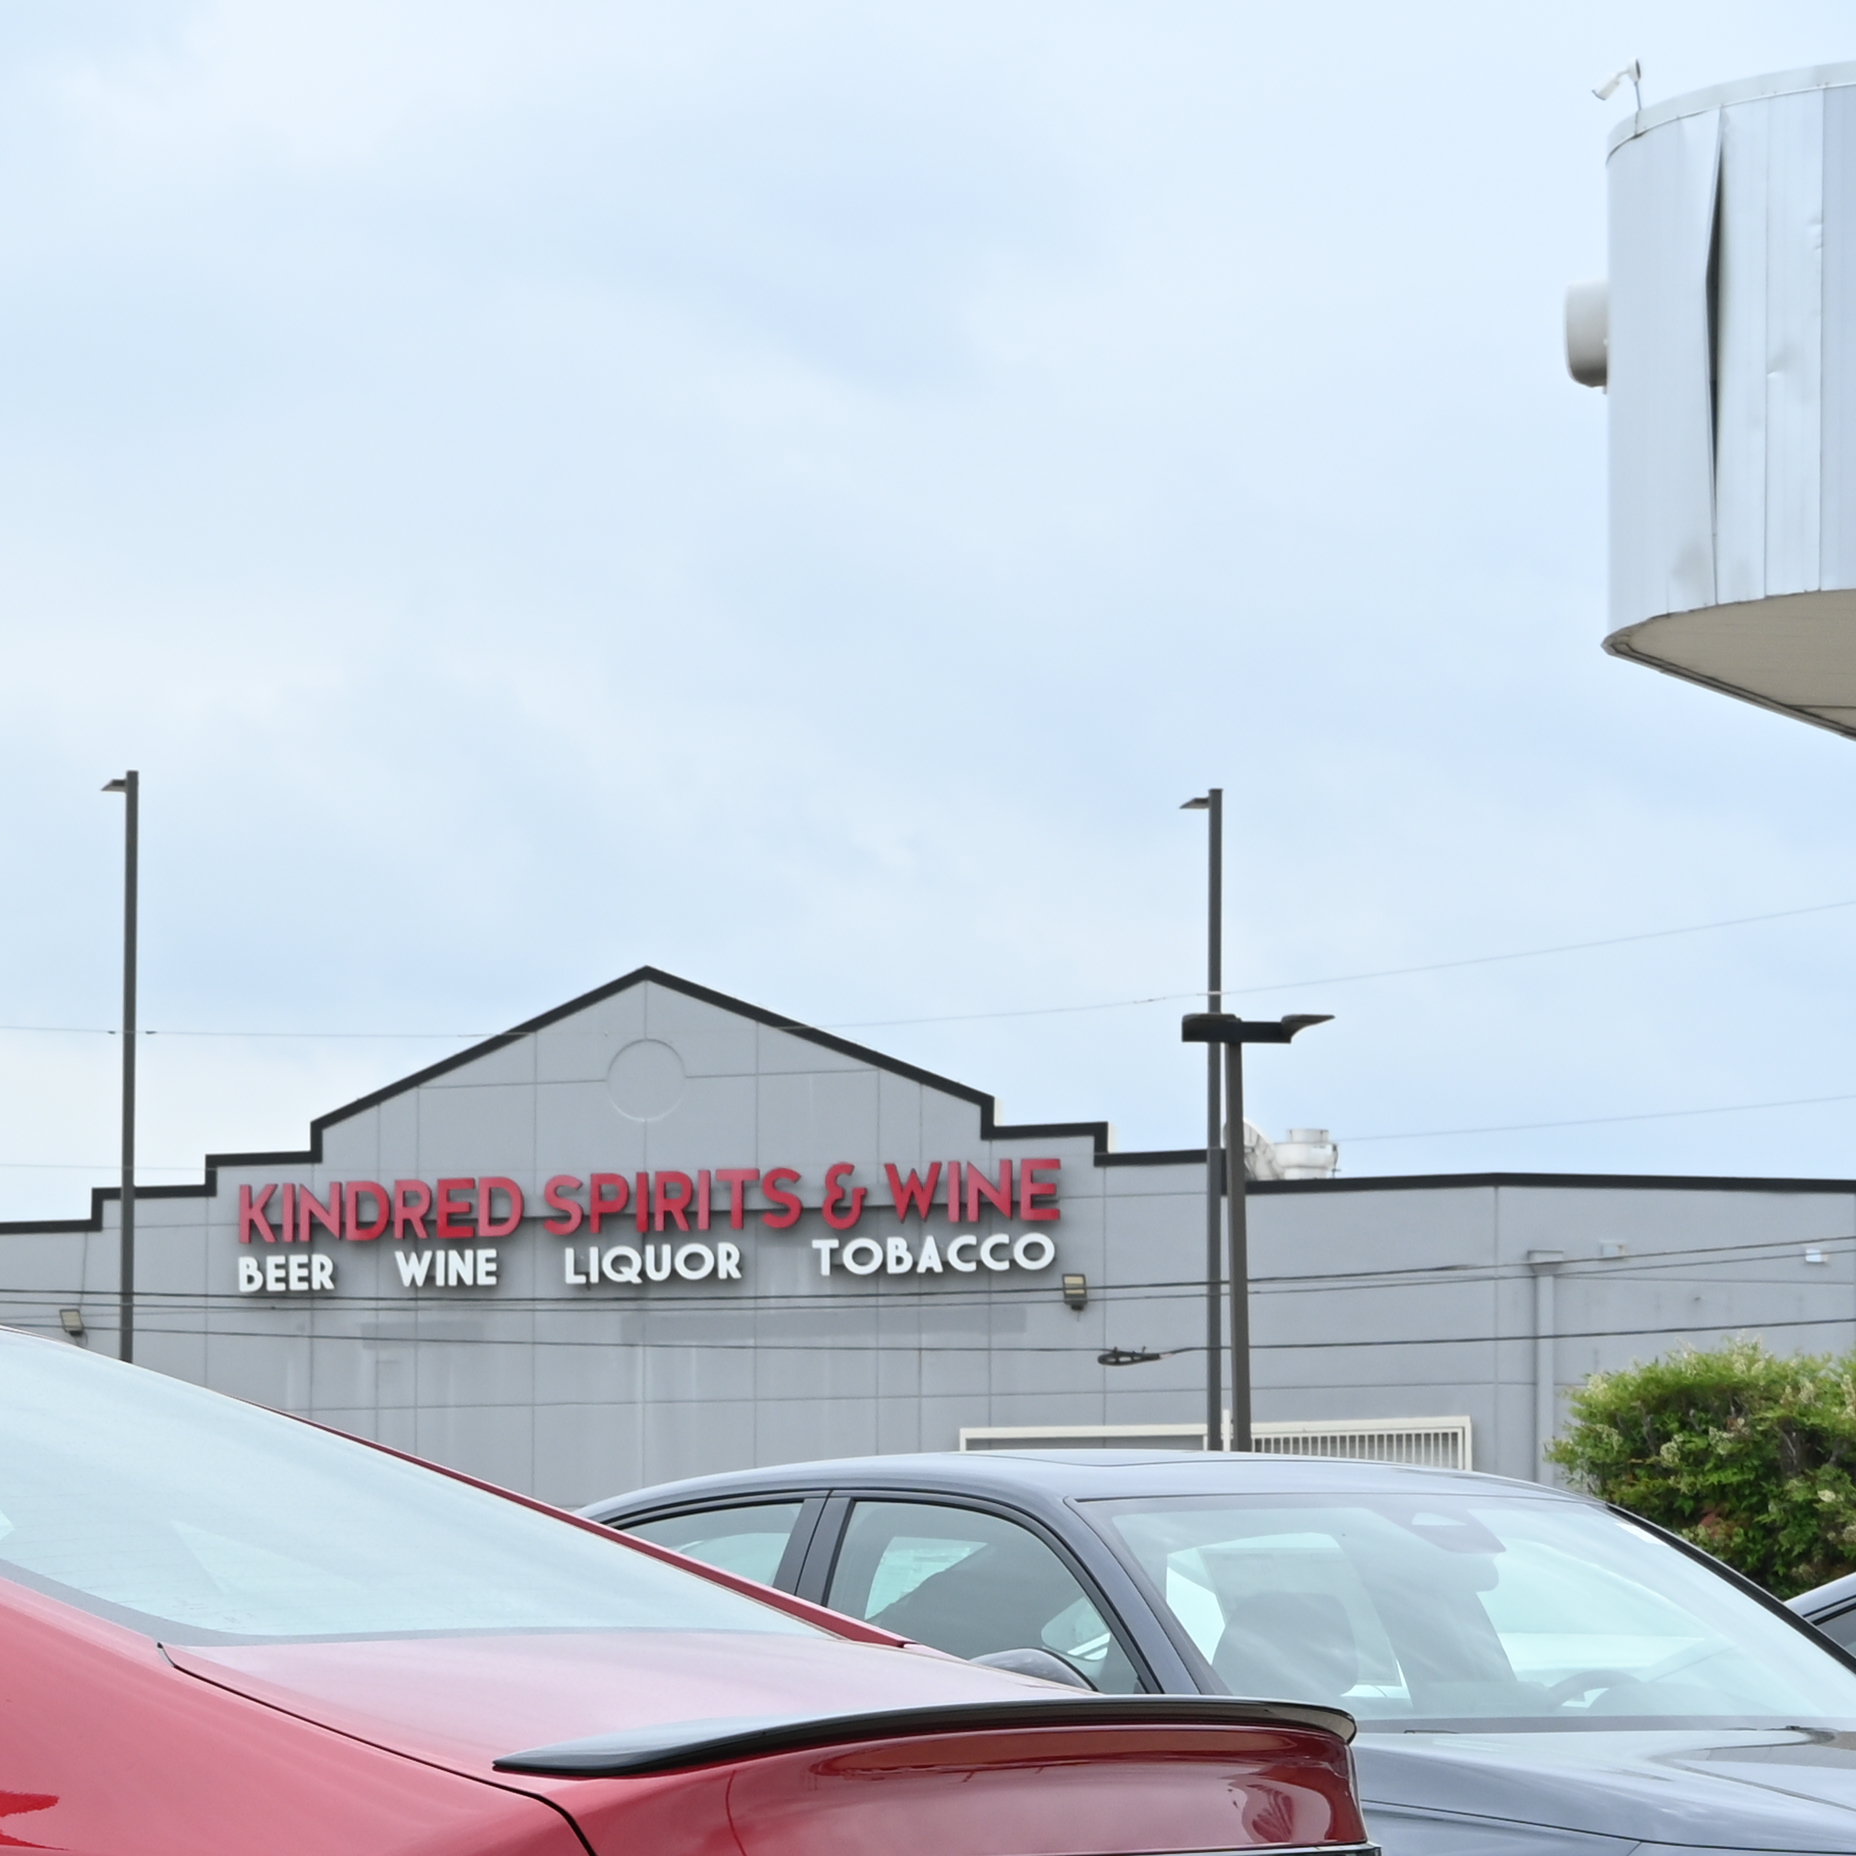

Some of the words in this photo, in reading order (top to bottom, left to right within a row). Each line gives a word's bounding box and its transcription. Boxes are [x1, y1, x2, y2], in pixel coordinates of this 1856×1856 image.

[238, 1175, 525, 1245] KINDRED
[542, 1167, 804, 1237] SPIRITS
[821, 1161, 868, 1230] &
[884, 1157, 1062, 1224] WINE
[237, 1253, 336, 1293] BEER
[393, 1247, 498, 1288] WINE
[564, 1240, 743, 1286] LIQUOR
[811, 1231, 1057, 1278] TOBACCO
